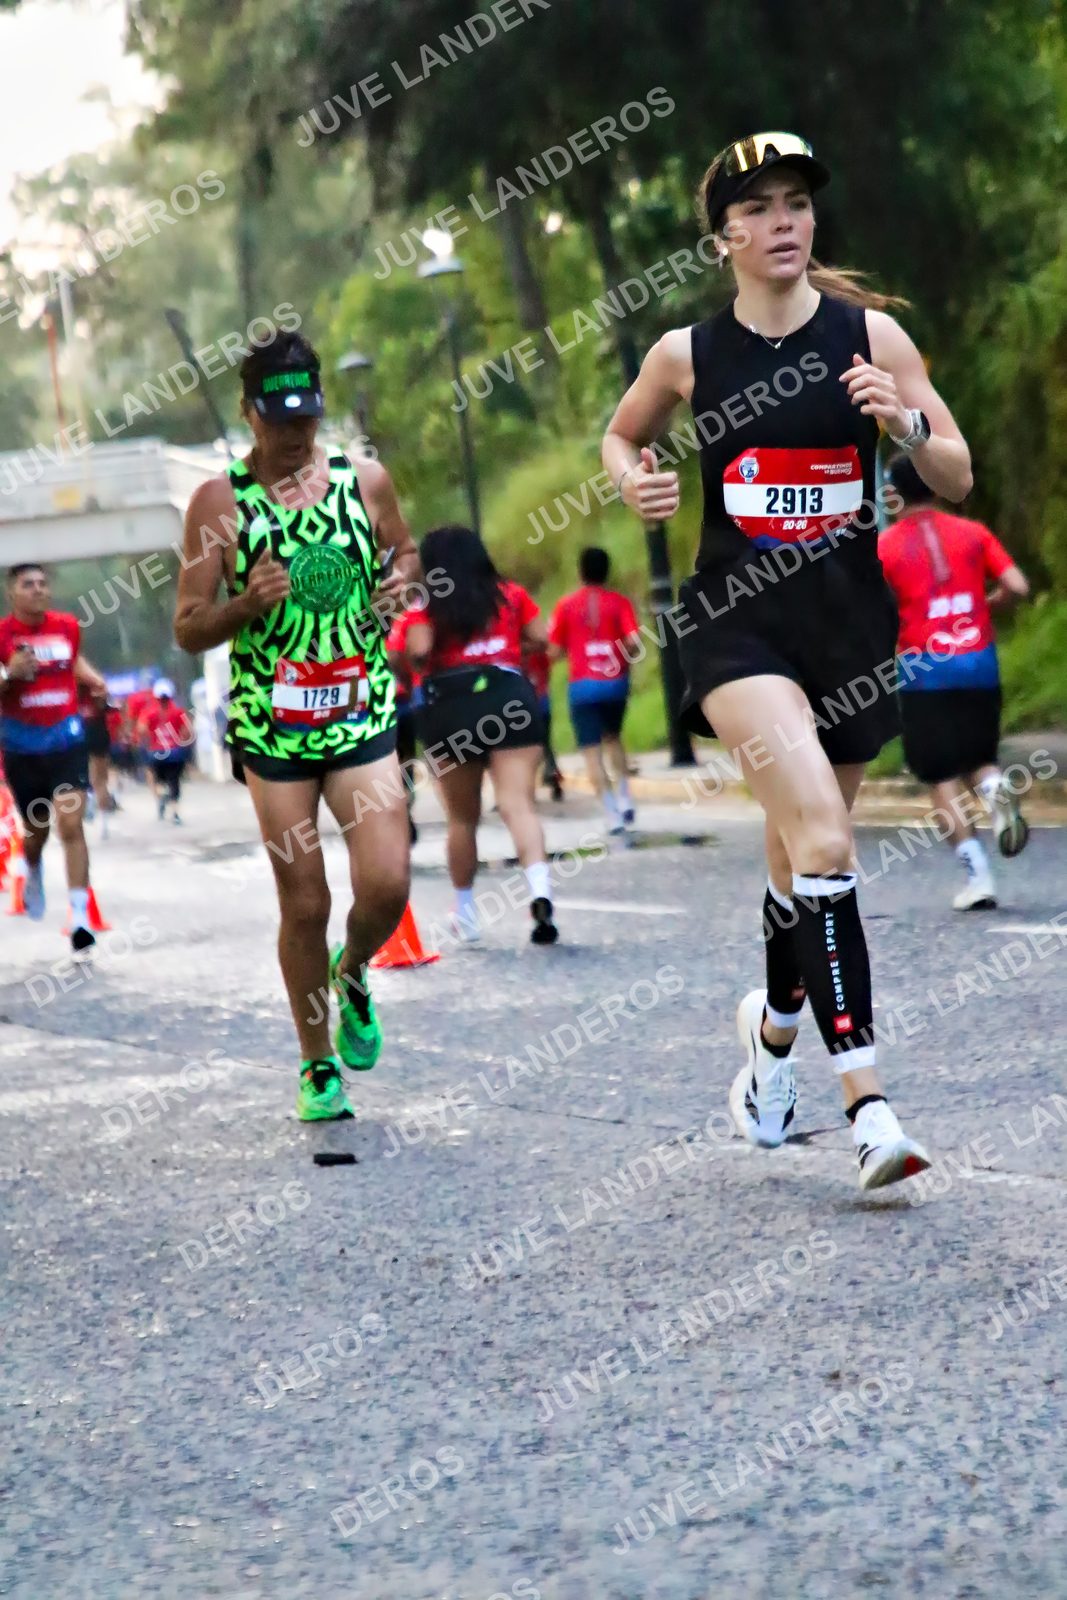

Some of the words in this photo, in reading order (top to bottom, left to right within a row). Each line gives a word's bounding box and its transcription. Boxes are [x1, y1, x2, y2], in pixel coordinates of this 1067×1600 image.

[766, 487, 823, 514] 2913
[303, 687, 340, 708] 1729
[825, 912, 845, 1011] COMPRESSPORT
